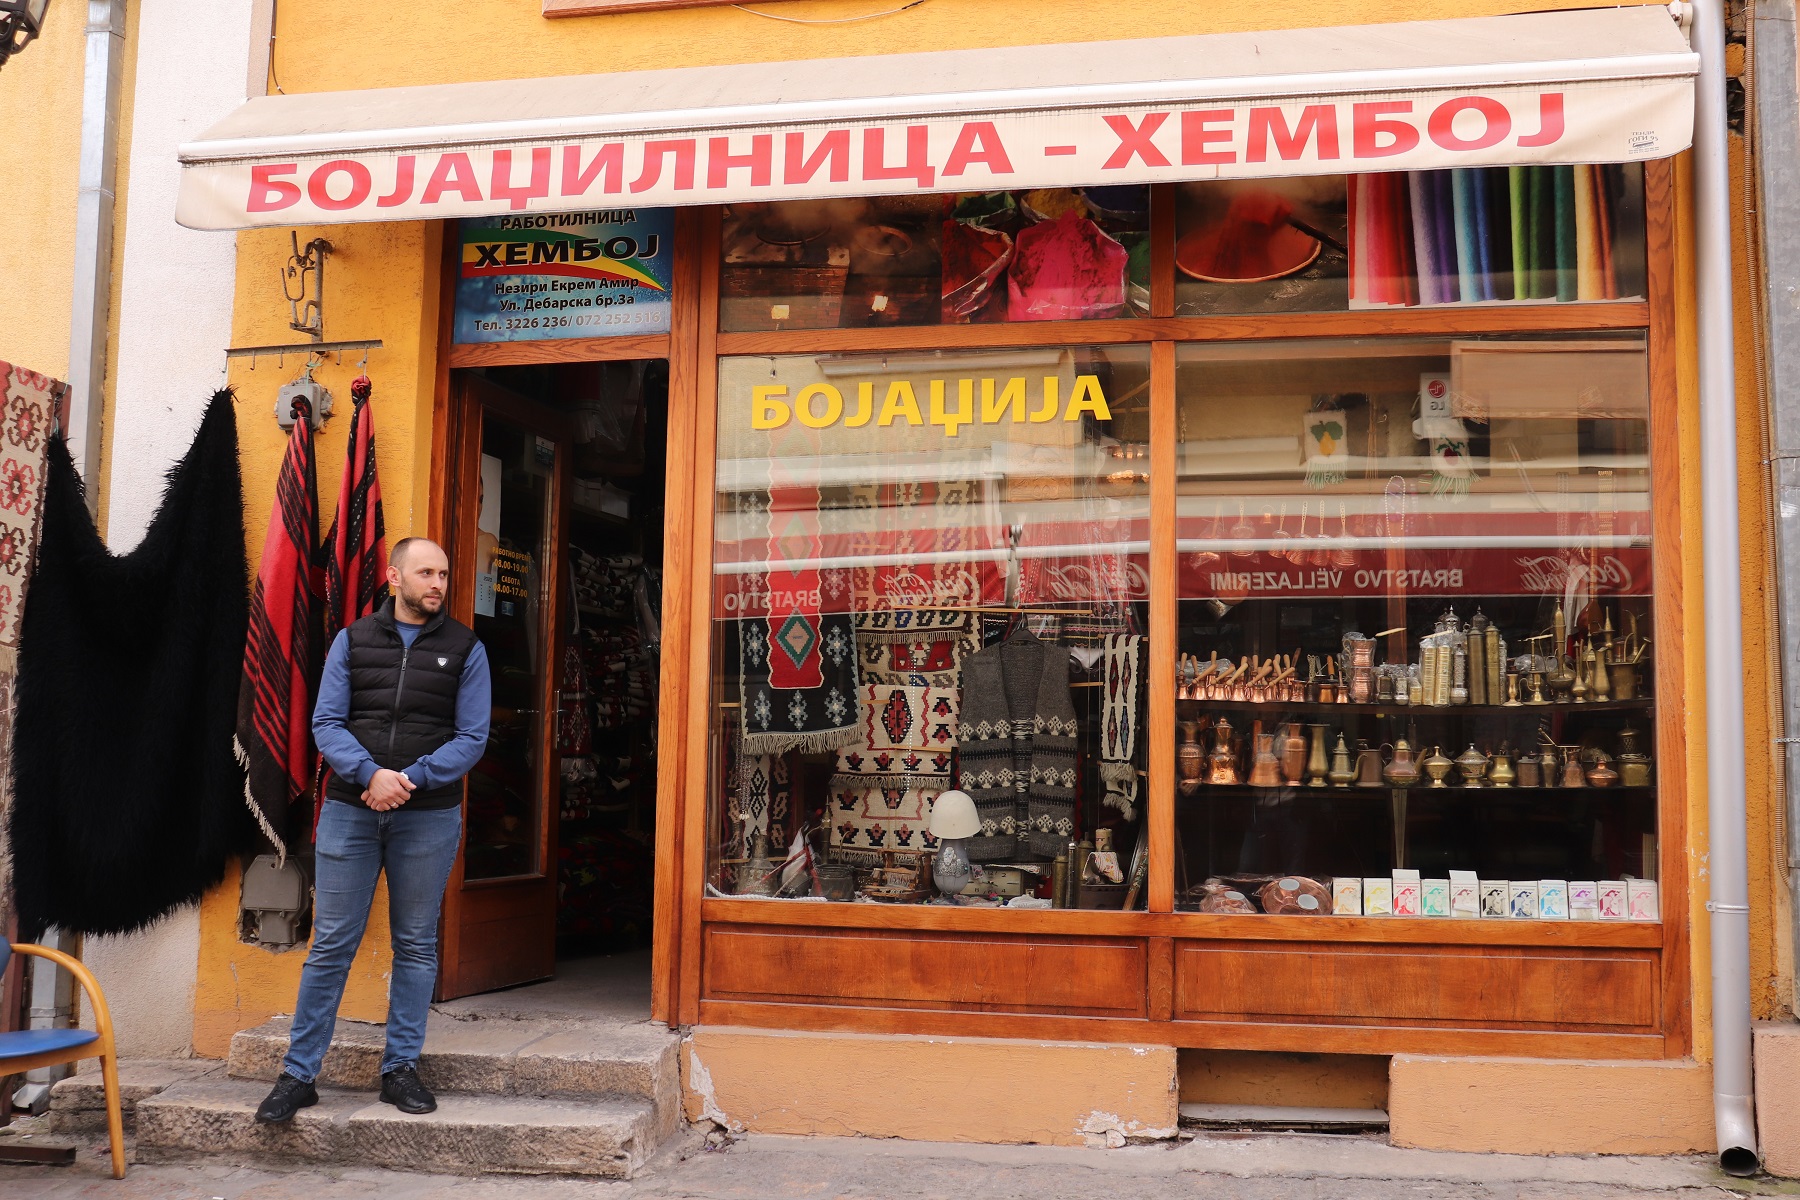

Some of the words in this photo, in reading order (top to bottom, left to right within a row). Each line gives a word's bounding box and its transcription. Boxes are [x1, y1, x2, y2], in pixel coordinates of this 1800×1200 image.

[246, 121, 1014, 213] БОЈАЏИЛНИЦА
[1101, 93, 1564, 170] ХЕМБОЈ
[500, 210, 636, 230] РАБОТИЛНИЦА
[474, 235, 659, 268] ХЕМБОЈ
[495, 282, 548, 296] Незири
[551, 280, 596, 294] Екрем
[599, 278, 639, 291] Амир
[500, 300, 521, 311] Ул.
[524, 298, 592, 312] Дебарска
[475, 319, 502, 331] Тел.
[506, 317, 539, 330] 3226
[542, 315, 573, 328] 236/
[576, 314, 601, 326] 072
[605, 313, 631, 325] 252
[636, 311, 661, 323] 516
[752, 375, 1113, 437] БОЈАЏИЈА
[501, 576, 520, 586] САБОТА
